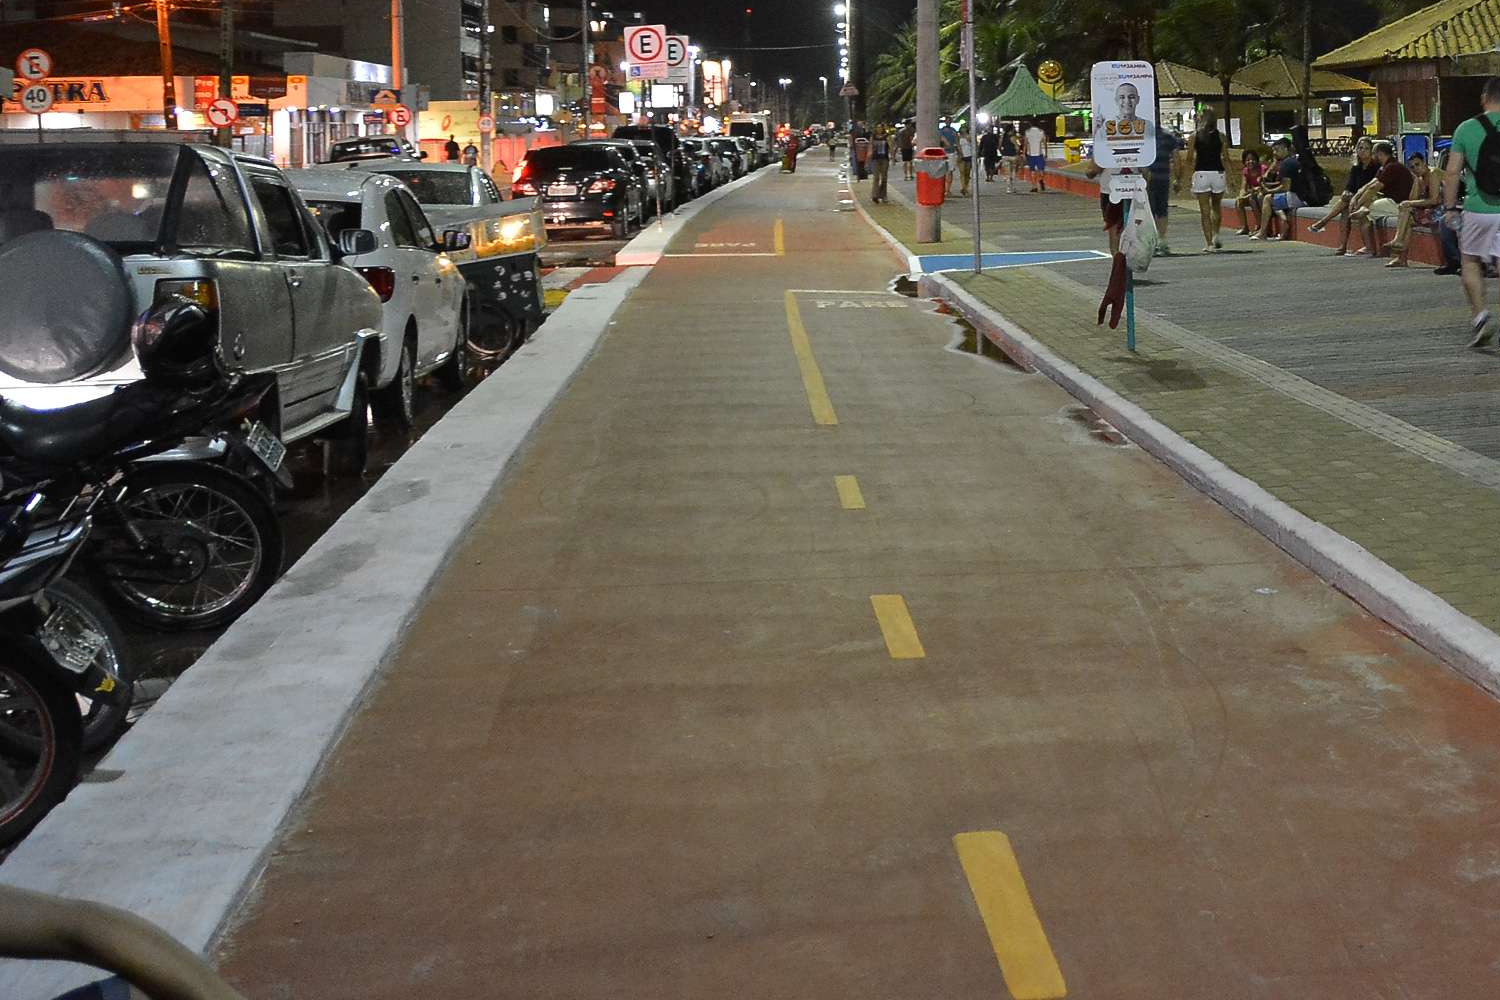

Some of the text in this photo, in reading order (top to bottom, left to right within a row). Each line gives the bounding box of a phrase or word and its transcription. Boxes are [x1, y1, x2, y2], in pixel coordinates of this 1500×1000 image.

[639, 34, 652, 54] E
[668, 44, 678, 60] E
[29, 56, 41, 75] E
[25, 88, 46, 103] 40
[815, 300, 908, 309] PARE
